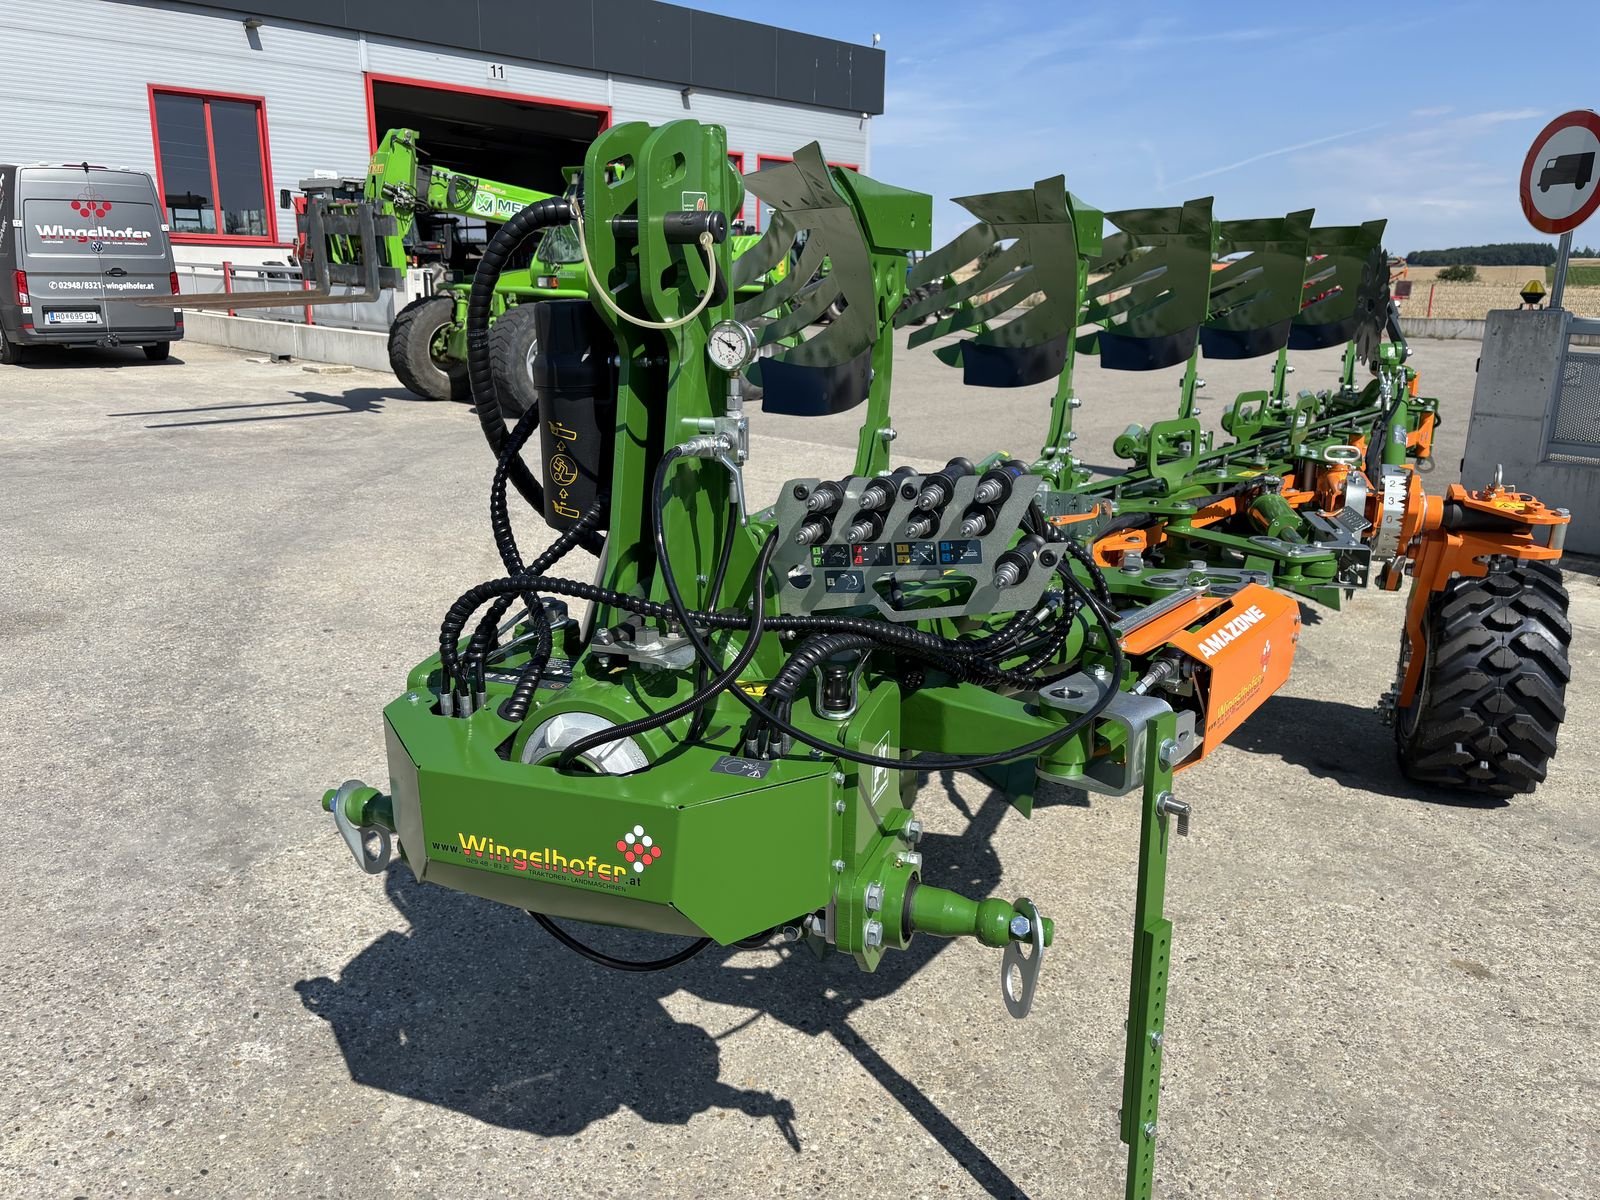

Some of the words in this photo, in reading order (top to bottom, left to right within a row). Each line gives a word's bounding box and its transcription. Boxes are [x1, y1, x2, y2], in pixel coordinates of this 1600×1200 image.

[490, 64, 504, 79] 11
[35, 224, 151, 243] Wingelhofer
[58, 281, 102, 290] 02948/8321
[106, 281, 154, 291] wingelhofer.at
[1389, 479, 1396, 488] 2
[1388, 496, 1395, 505] 3
[1197, 604, 1267, 660] AMAZONE
[528, 869, 567, 881] TRAKTOREN
[570, 877, 627, 892] LANDMASCHINEN
